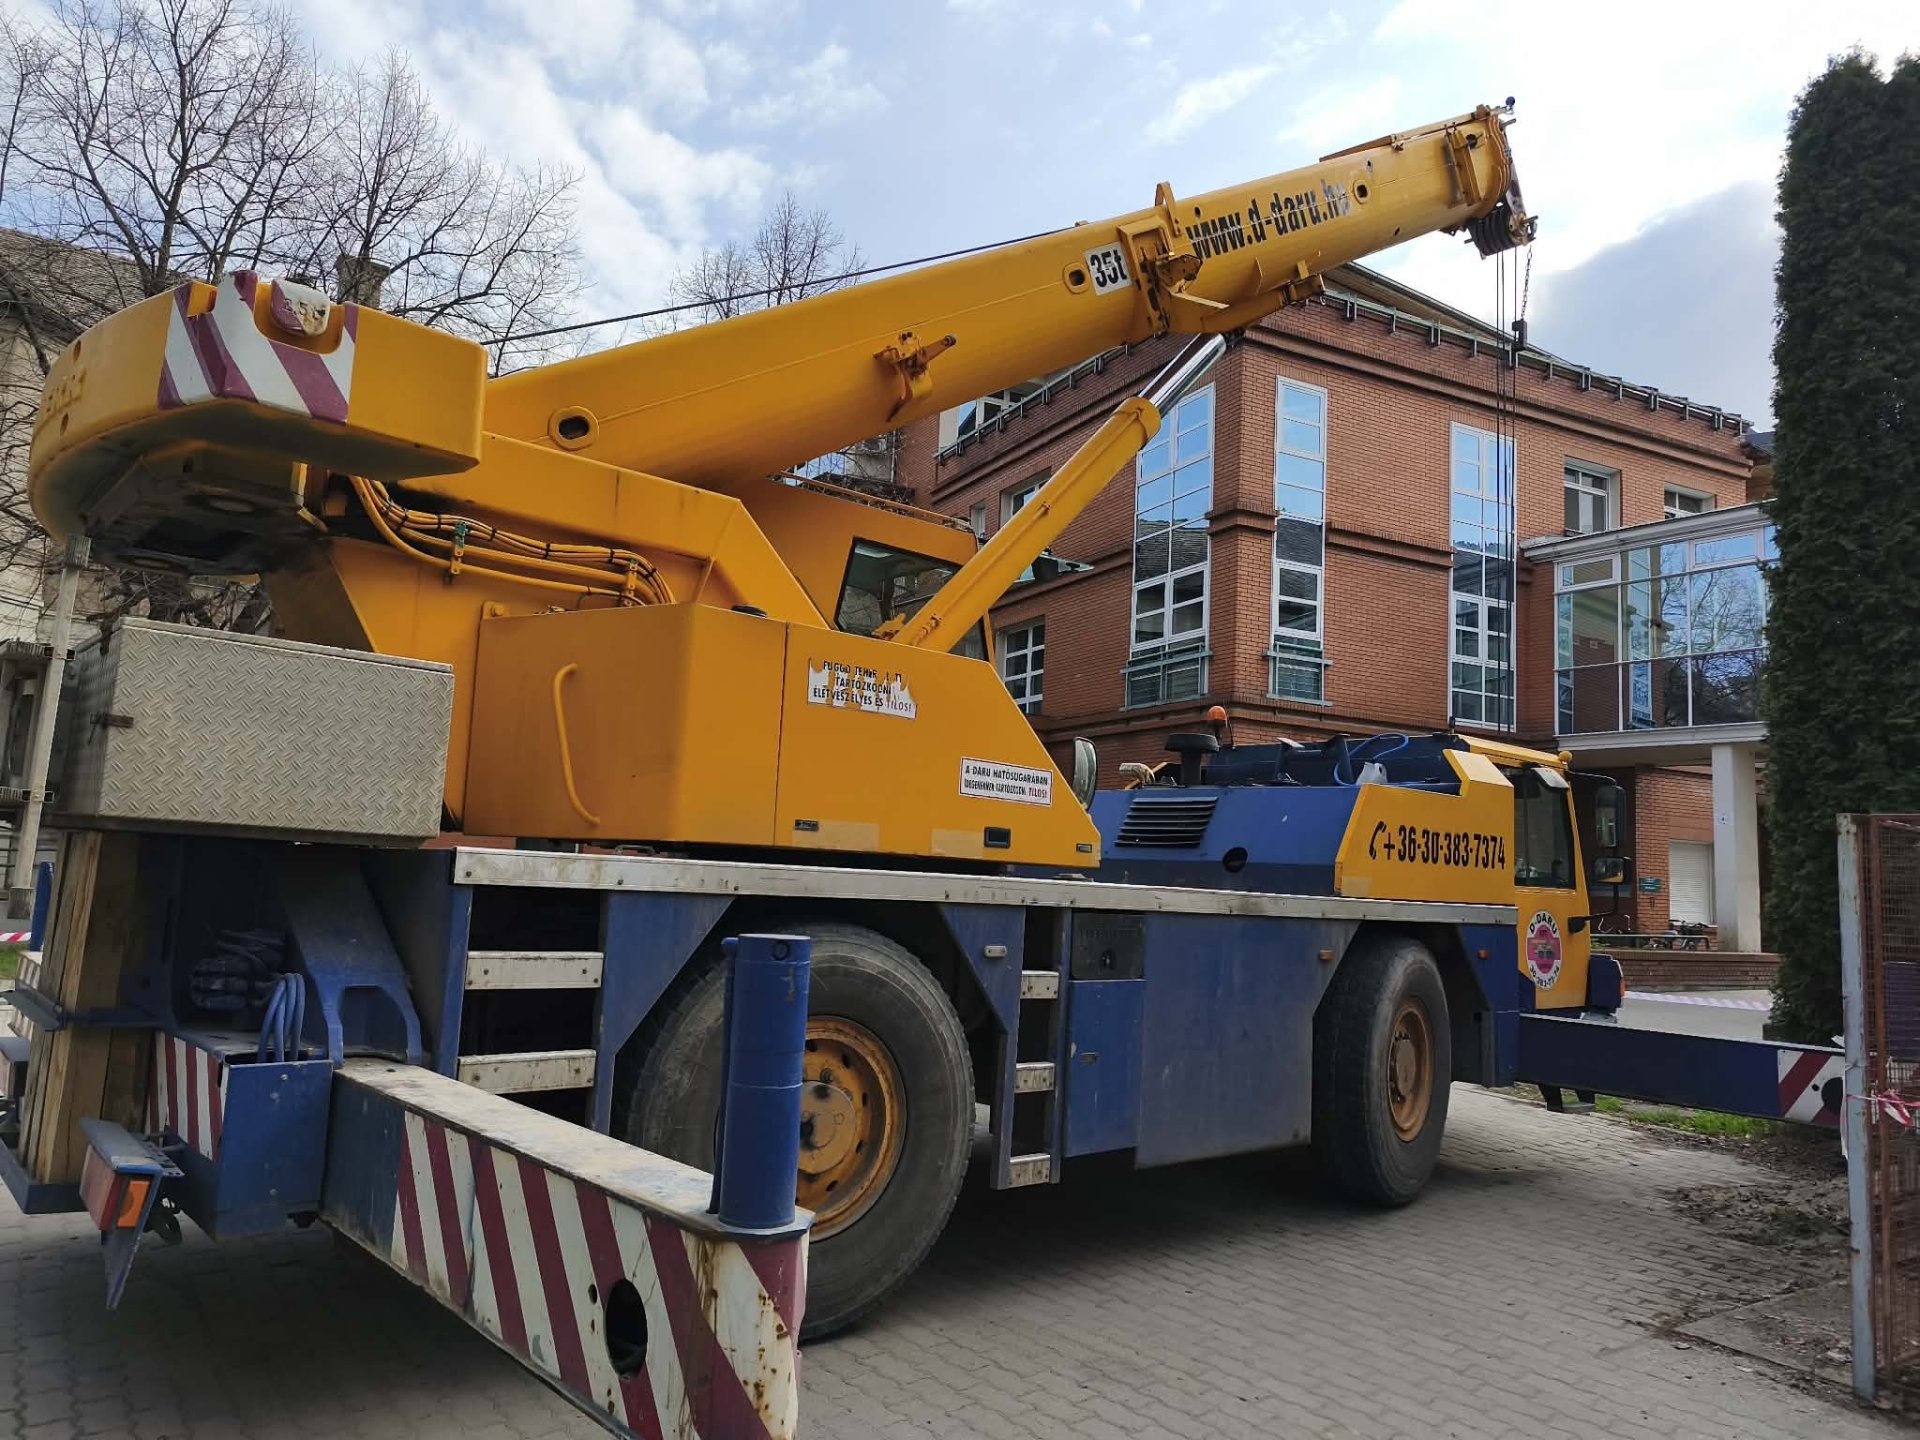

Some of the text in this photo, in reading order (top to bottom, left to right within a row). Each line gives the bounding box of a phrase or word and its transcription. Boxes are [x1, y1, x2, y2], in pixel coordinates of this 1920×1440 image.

[1090, 249, 1127, 288] 35t
[965, 765, 970, 774] A
[973, 766, 991, 777] DARU
[1028, 787, 1047, 798] TILOS!
[1530, 912, 1557, 934] D-DARU
